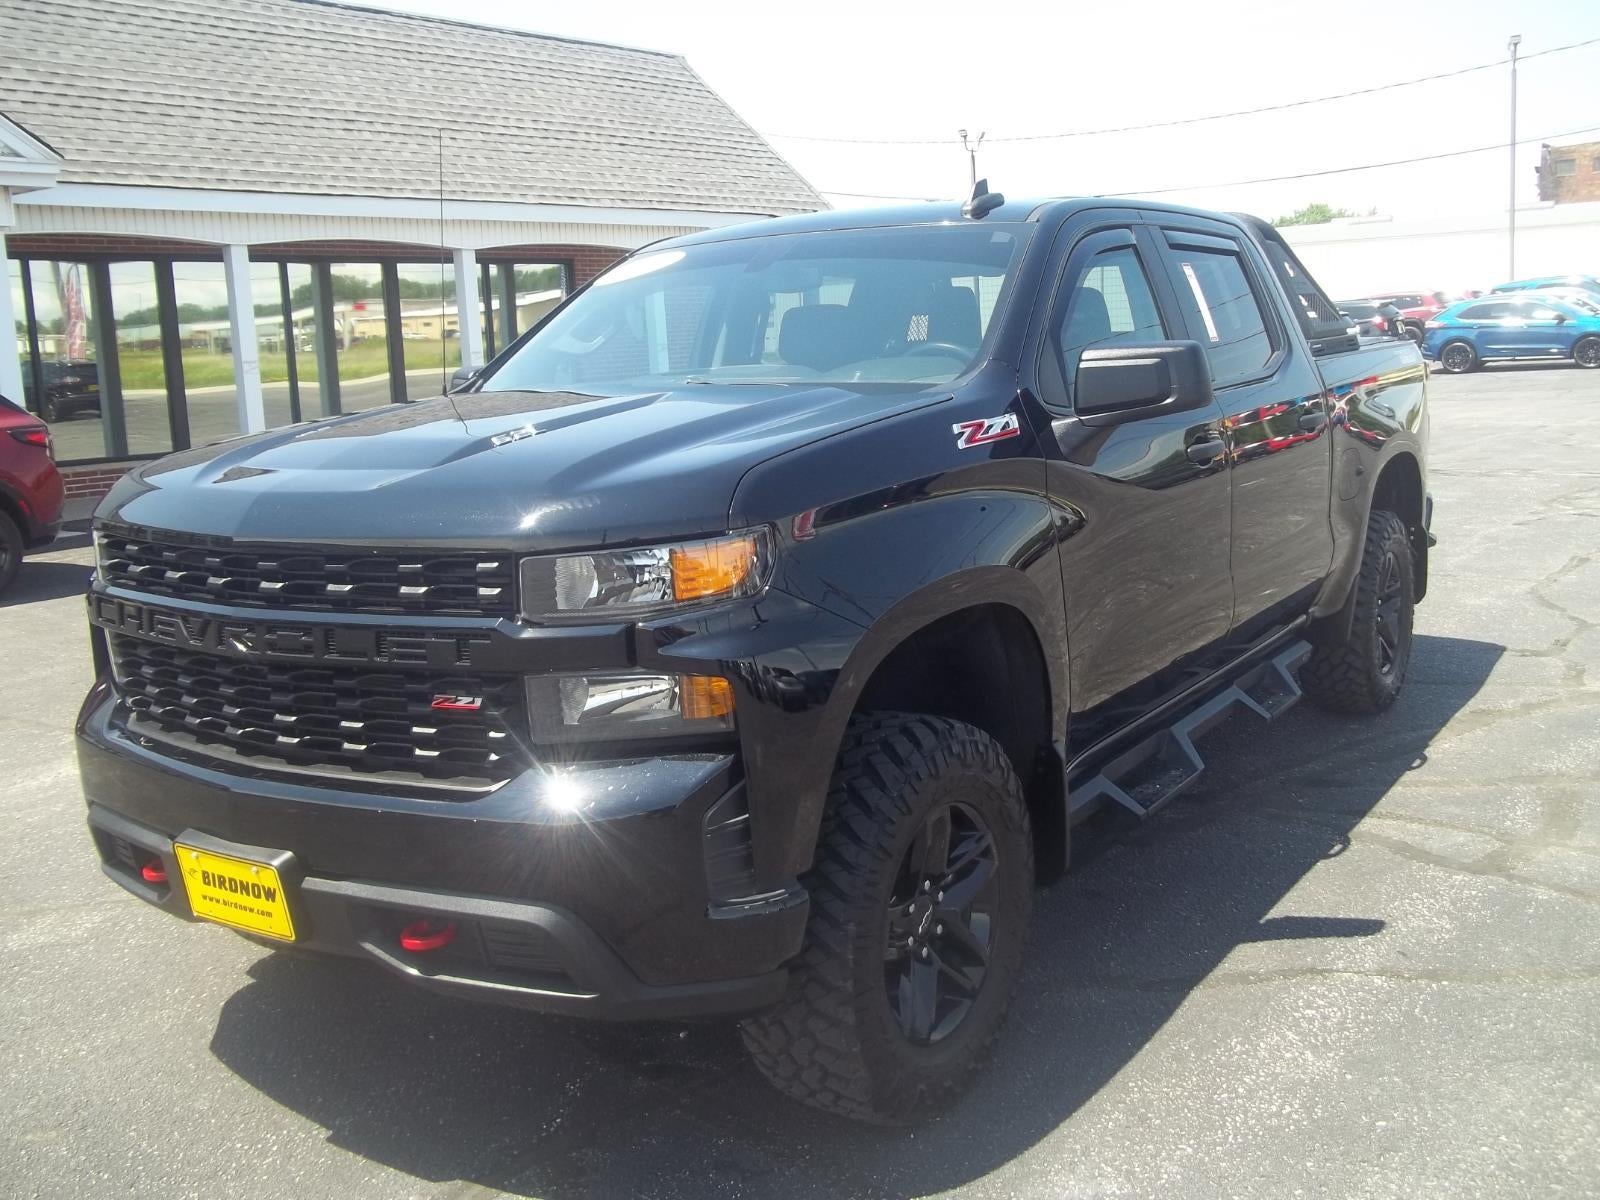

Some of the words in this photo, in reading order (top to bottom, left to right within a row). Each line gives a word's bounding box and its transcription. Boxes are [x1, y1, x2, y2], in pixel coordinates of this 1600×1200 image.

[952, 411, 1020, 450] Z71
[97, 596, 493, 667] CHEVROLET
[431, 694, 483, 710] Z71
[201, 869, 277, 903] BIRDNOW
[201, 894, 273, 919] www.birdnow.com
